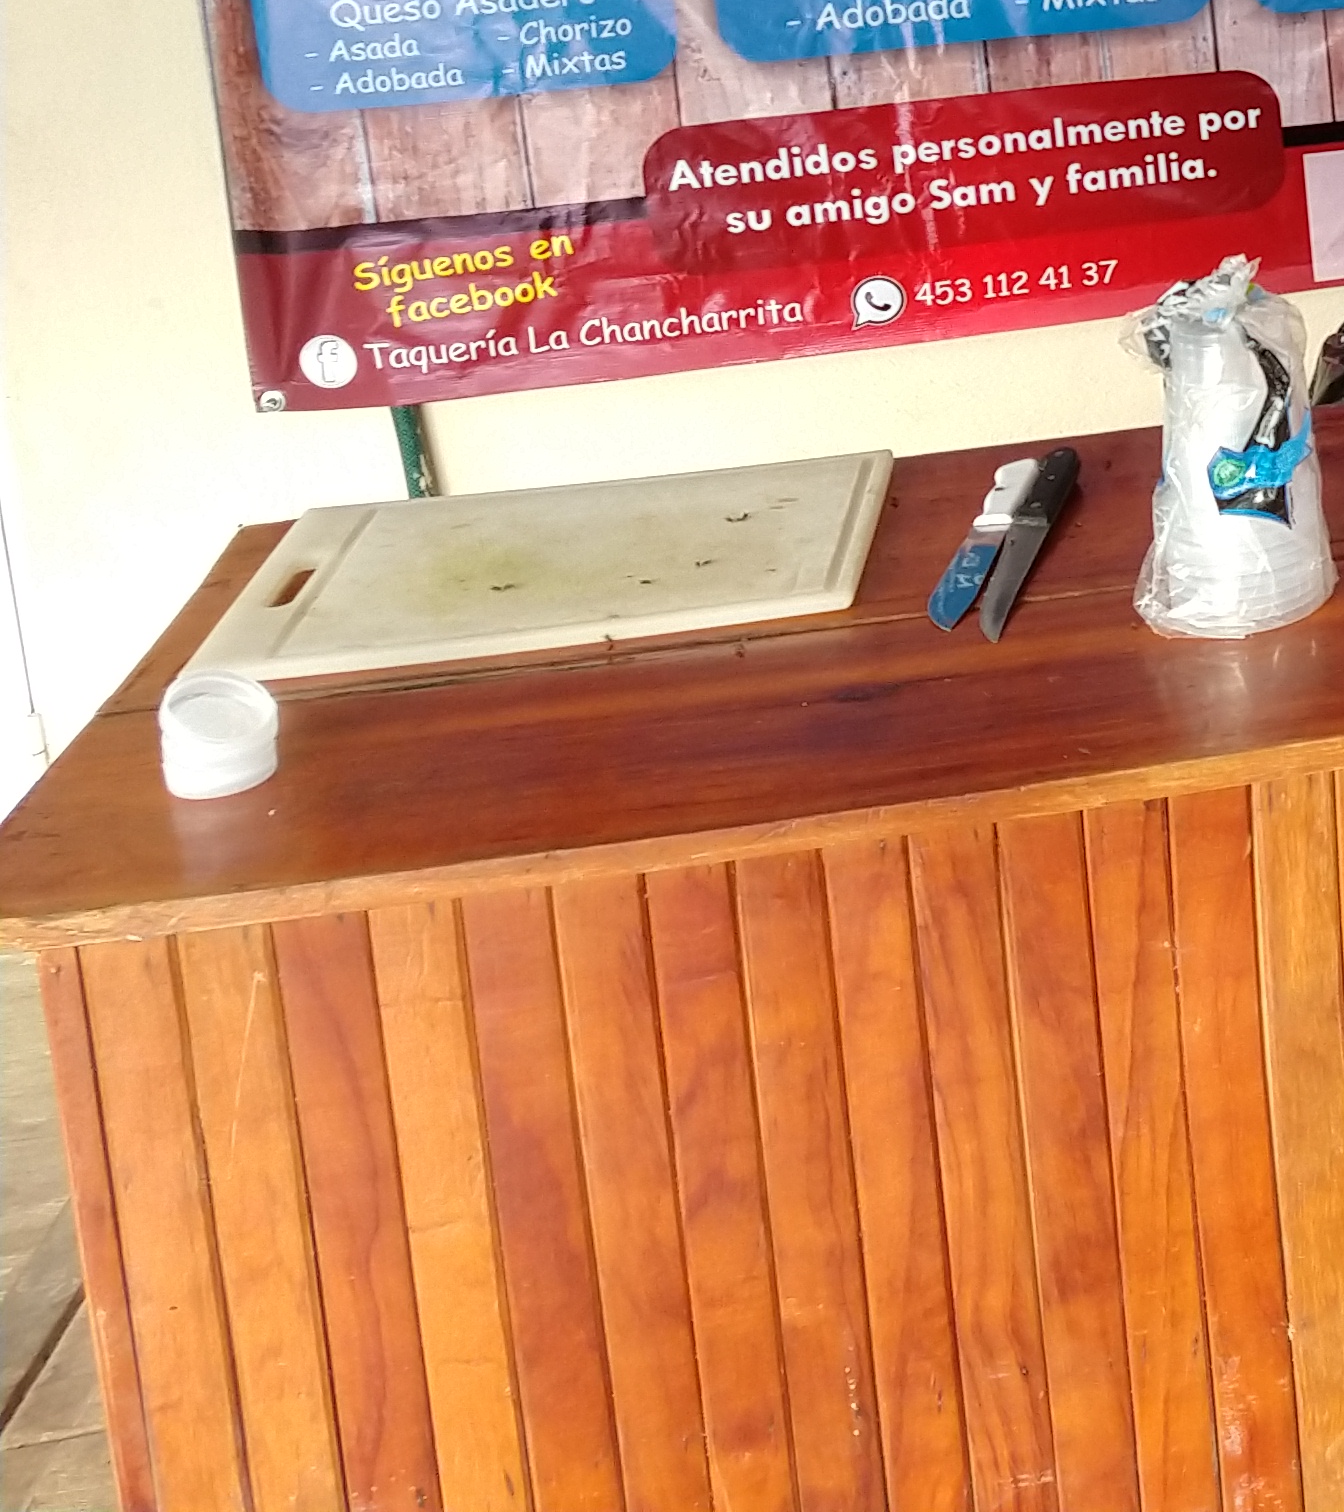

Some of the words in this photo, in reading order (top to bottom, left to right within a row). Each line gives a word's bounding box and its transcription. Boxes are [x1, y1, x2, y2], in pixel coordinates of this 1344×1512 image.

[329, 35, 420, 62] Asada
[519, 16, 631, 46] Chorizo
[335, 64, 464, 94] Adobada
[525, 47, 627, 78] Mixtas
[667, 143, 879, 193] Atendidos
[893, 112, 1185, 174] personalmente
[1198, 105, 1261, 141] por
[726, 204, 776, 235] su
[786, 183, 915, 229] amigo
[928, 177, 1019, 212] Sam
[1029, 177, 1054, 209] y
[1067, 153, 1218, 194] familia.
[353, 245, 513, 294] Síguenos
[530, 233, 573, 260] en
[915, 277, 973, 307] 453
[984, 271, 1030, 299] 112
[1039, 265, 1072, 292] 41
[1080, 259, 1117, 286] 37
[385, 272, 557, 327] facebook
[364, 329, 520, 373] Taquería
[528, 322, 569, 354] La
[580, 296, 803, 348] Chancharrita
